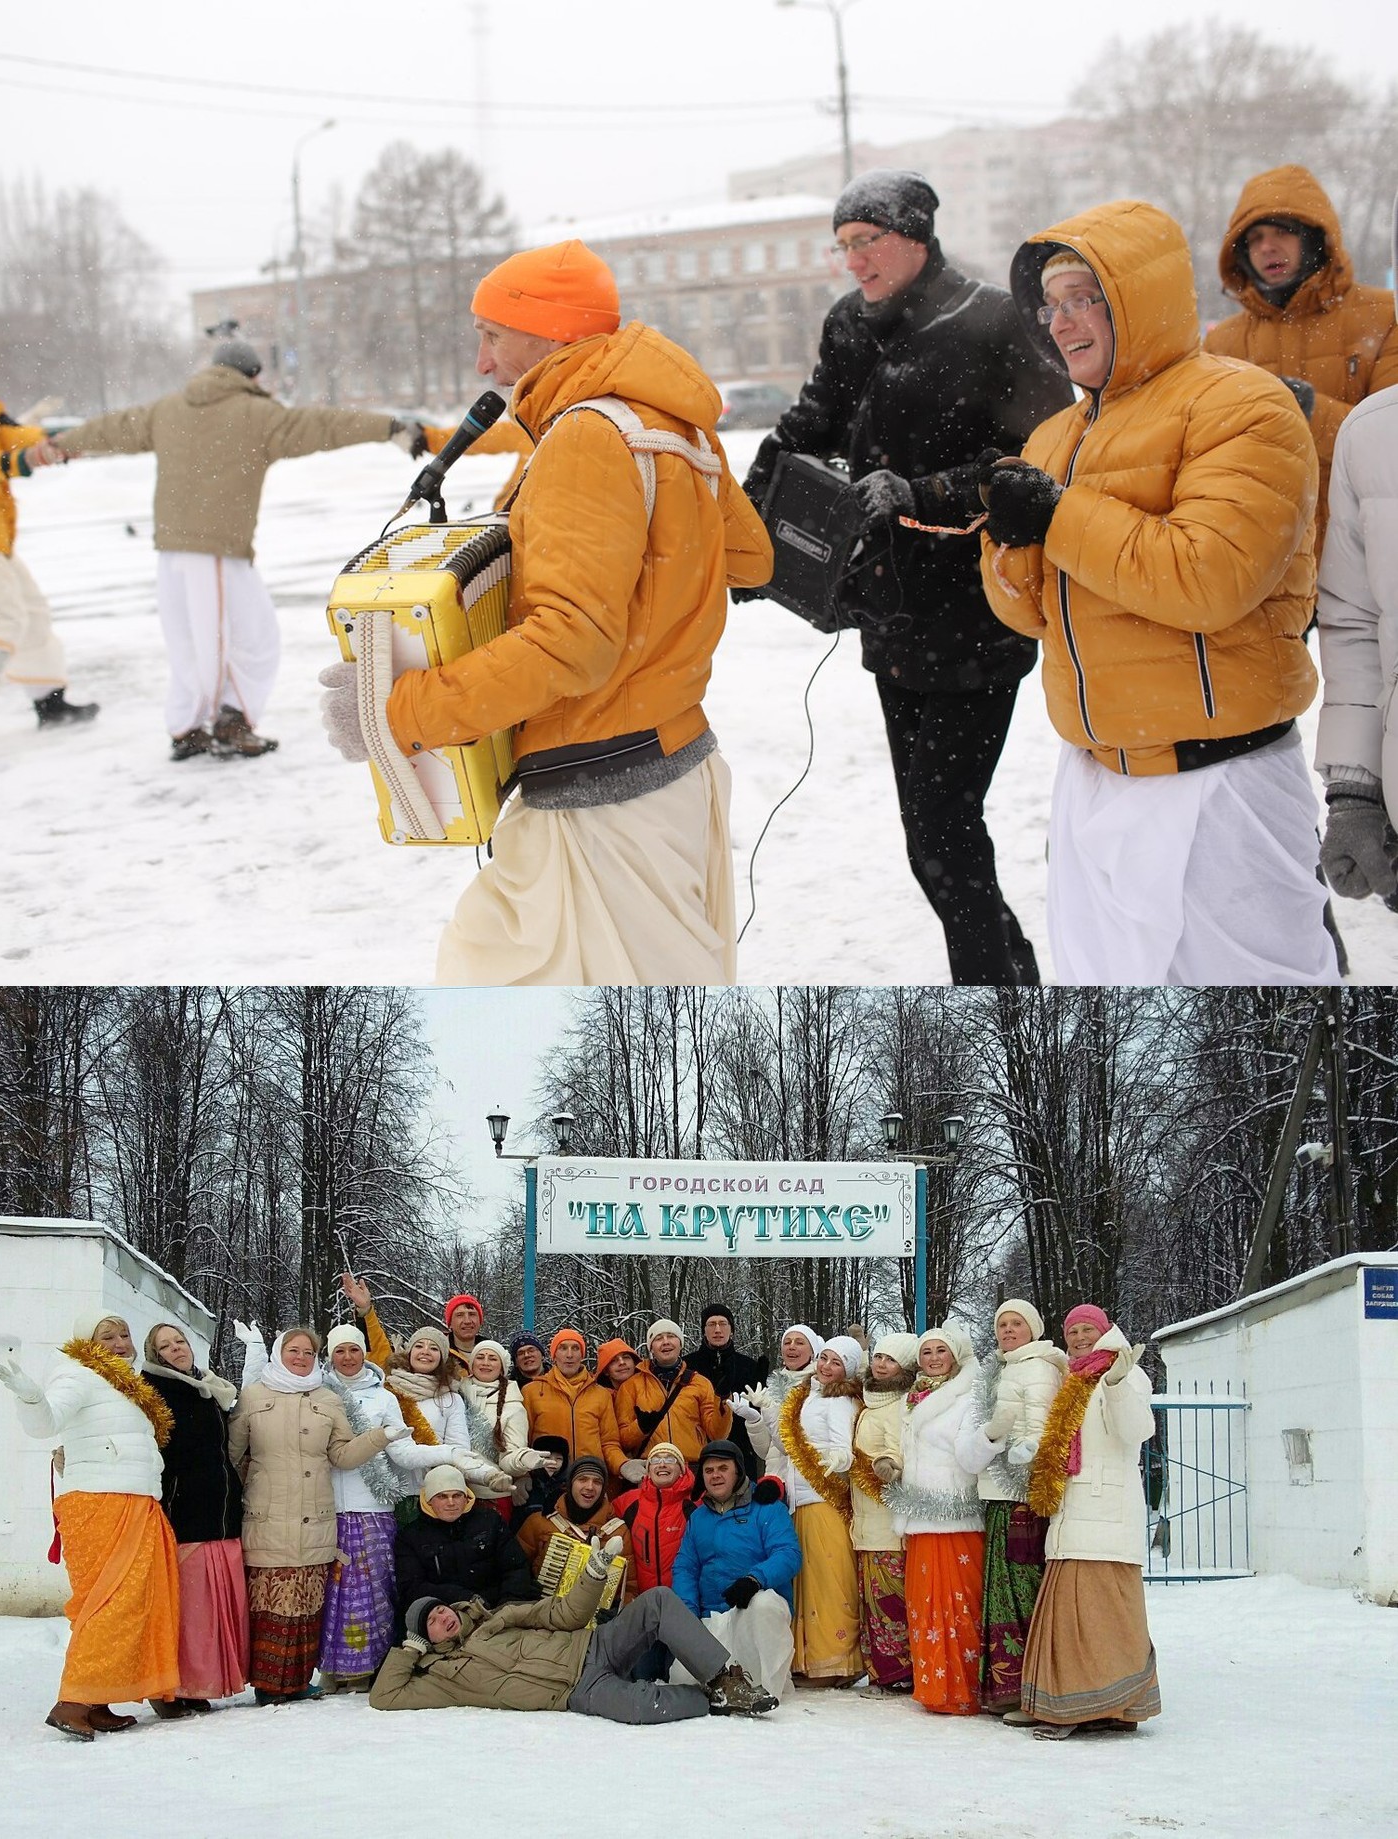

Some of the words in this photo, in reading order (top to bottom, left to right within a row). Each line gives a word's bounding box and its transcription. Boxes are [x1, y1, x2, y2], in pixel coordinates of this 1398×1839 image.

[628, 1175, 769, 1194] ГОРОДСКОЙ
[778, 1178, 825, 1195] САД
[568, 1200, 648, 1236] "НА
